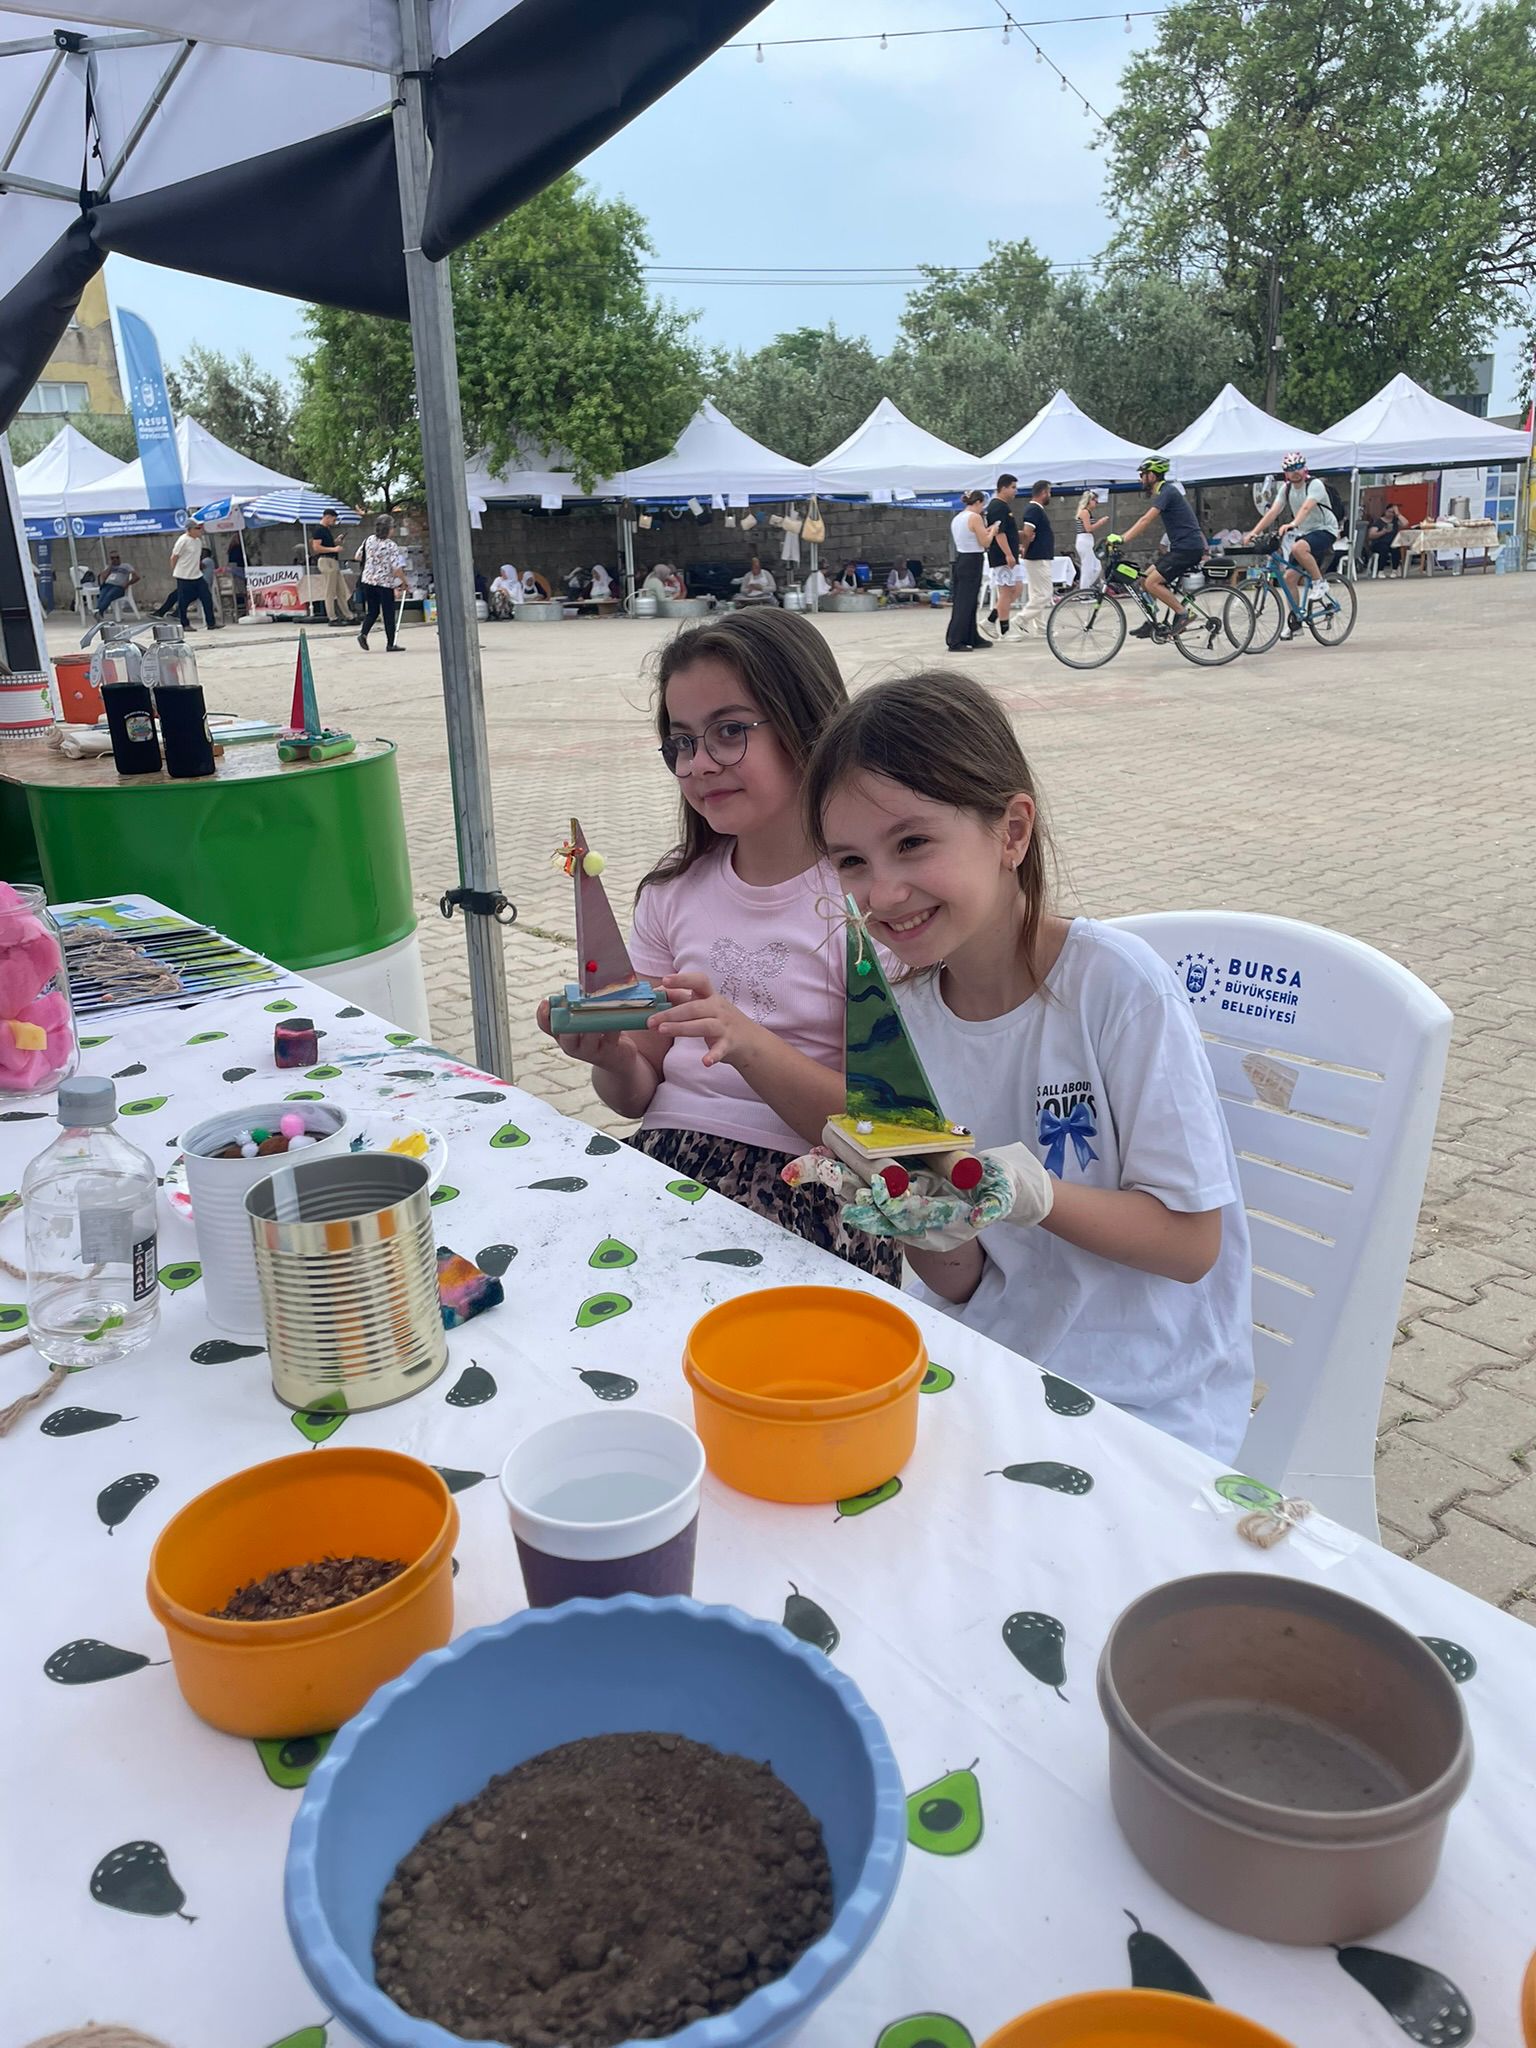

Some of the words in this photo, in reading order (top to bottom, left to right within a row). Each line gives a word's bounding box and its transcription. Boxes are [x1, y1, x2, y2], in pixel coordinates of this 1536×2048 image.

[1228, 958, 1301, 988] BURSA
[1224, 980, 1299, 1006] BÜYÜKŞEHİR
[1221, 999, 1297, 1025] BELEDİYESİ
[1042, 1084, 1060, 1097] ALL
